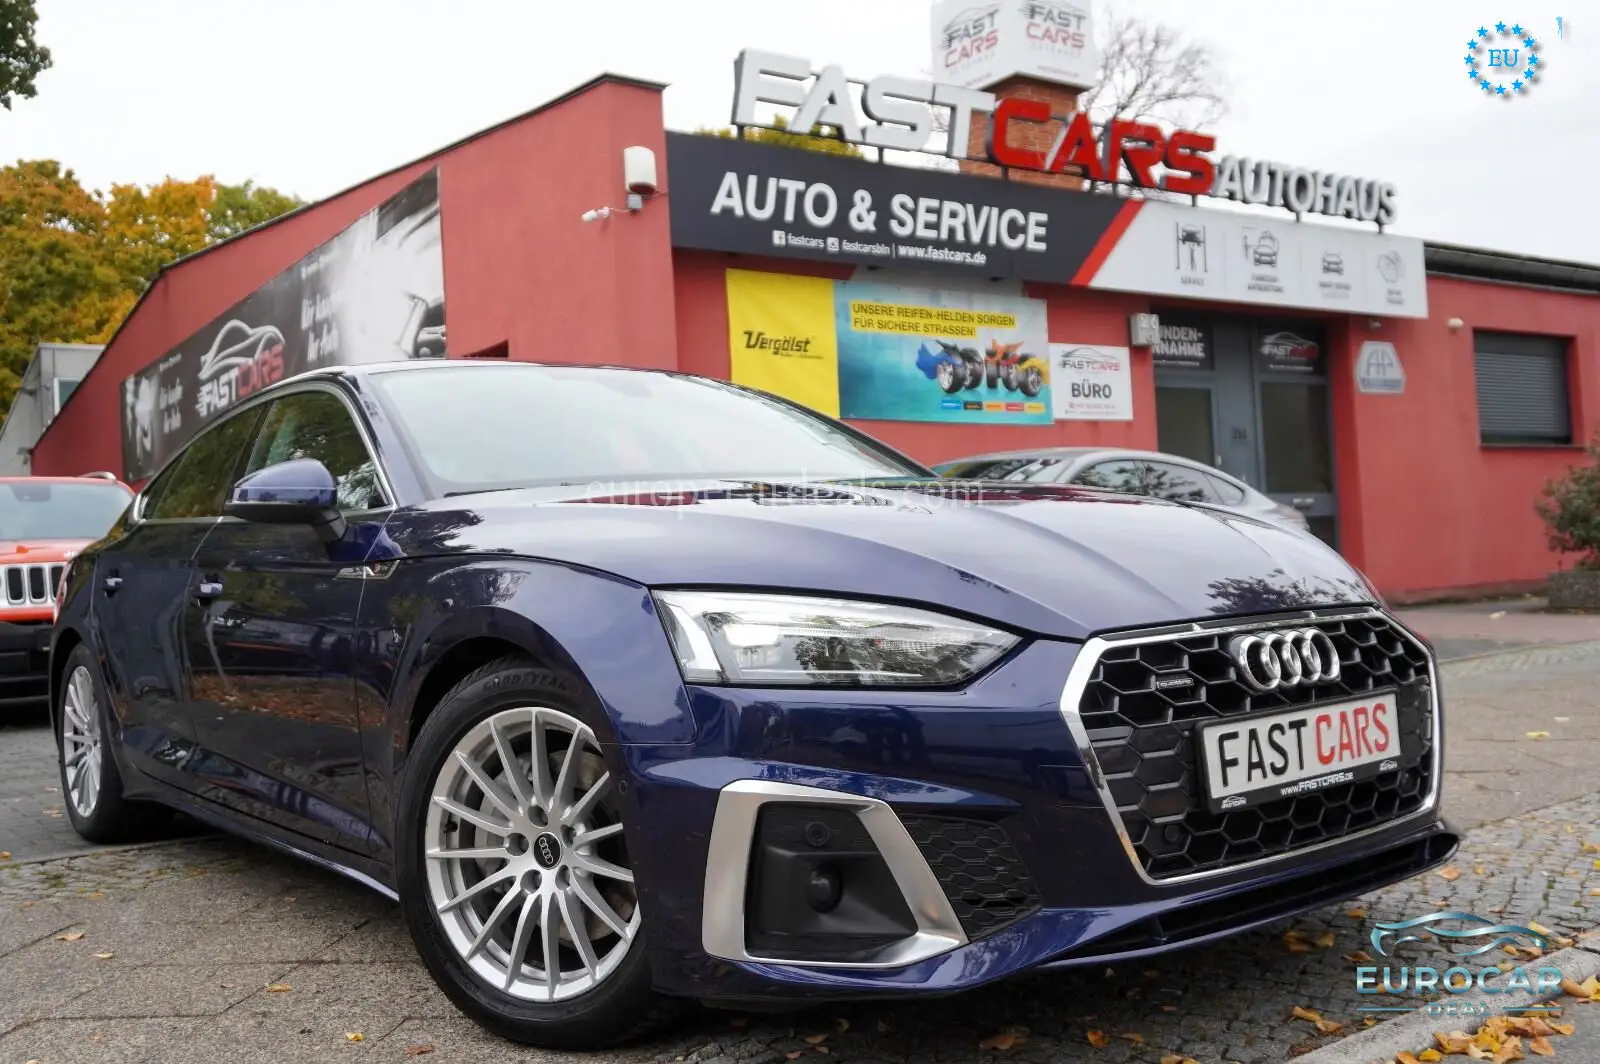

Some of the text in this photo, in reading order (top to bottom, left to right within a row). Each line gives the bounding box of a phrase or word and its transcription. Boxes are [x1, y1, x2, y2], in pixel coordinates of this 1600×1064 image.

[1029, 4, 1086, 30] FAST
[1026, 22, 1086, 49] CARS
[1215, 155, 1398, 225] AUTOHAUS
[710, 171, 1049, 250] AUTO & SERVICE
[899, 244, 987, 265] www.fastcars.de
[853, 303, 895, 316] UNSERE
[976, 313, 1015, 327] SORGEN
[877, 319, 921, 332] SICHERE
[923, 323, 976, 337] STRASSEN!
[743, 330, 811, 355] Vergölst
[1071, 378, 1112, 399] BÜRO
